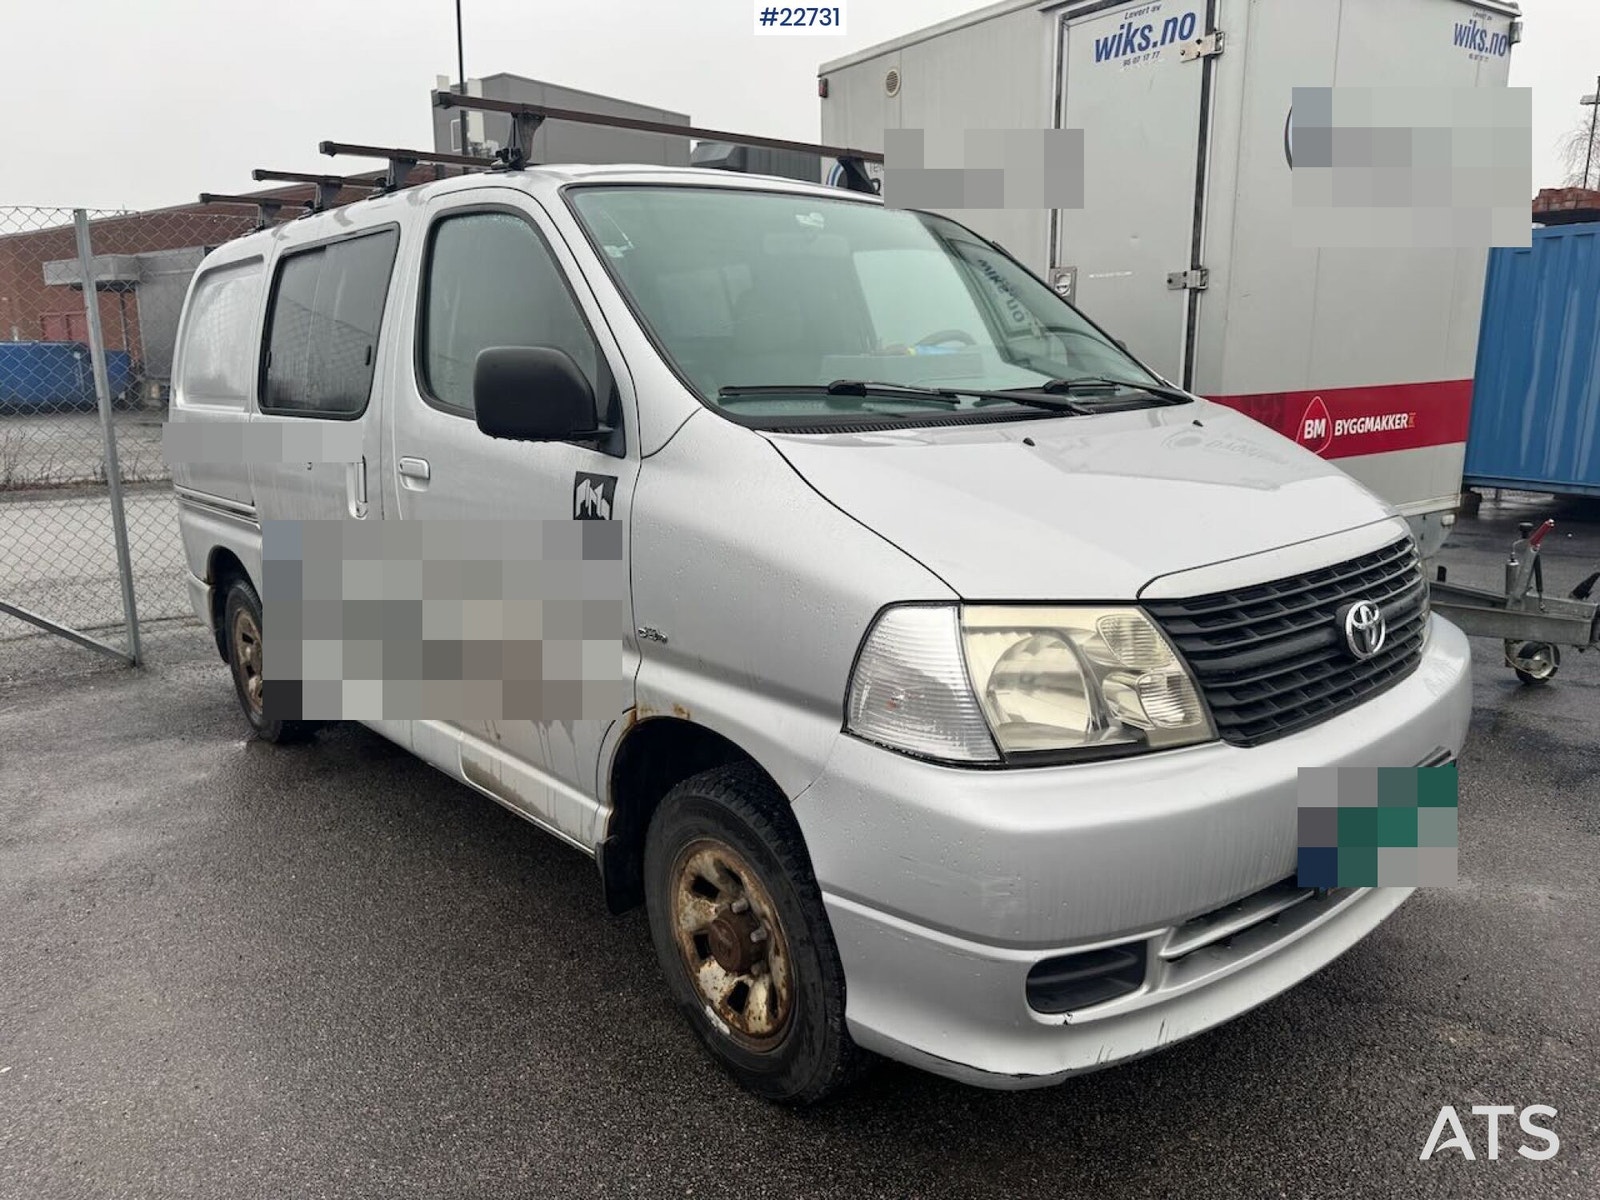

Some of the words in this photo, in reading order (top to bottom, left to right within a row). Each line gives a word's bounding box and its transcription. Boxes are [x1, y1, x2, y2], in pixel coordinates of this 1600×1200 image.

[1095, 12, 1196, 62] wiks.no
[1454, 19, 1507, 57] wiks.no
[1303, 418, 1326, 439] BM
[1334, 413, 1408, 436] BYGGMAKKER
